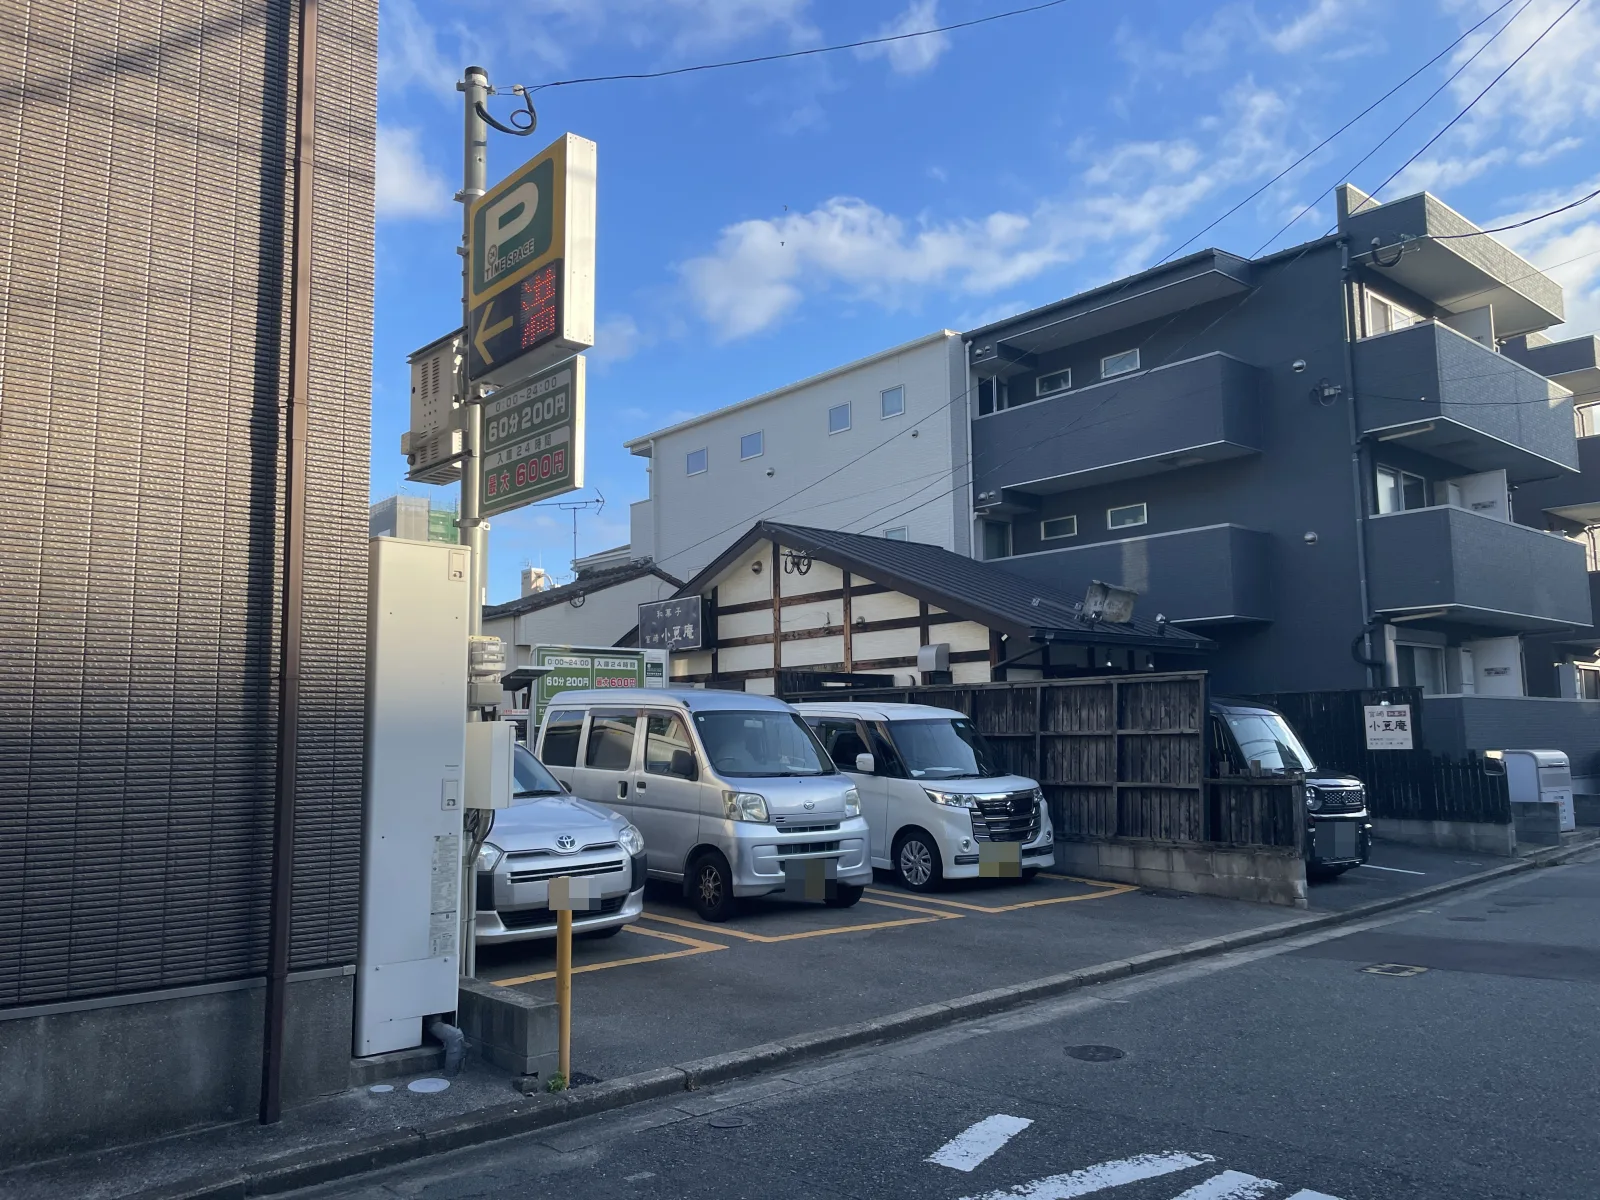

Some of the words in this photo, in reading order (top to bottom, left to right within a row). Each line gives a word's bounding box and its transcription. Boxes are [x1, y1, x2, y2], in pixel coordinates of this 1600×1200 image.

[485, 182, 539, 282] P
[485, 257, 506, 280] TIME
[507, 238, 535, 267] SPACE
[488, 392, 566, 442] 60分200円
[488, 449, 565, 496] 最大600円
[661, 624, 694, 642] 小豆庵
[546, 676, 589, 687] 60分200円
[595, 677, 636, 687] 最大600円
[1369, 720, 1407, 731] 小豆庵
